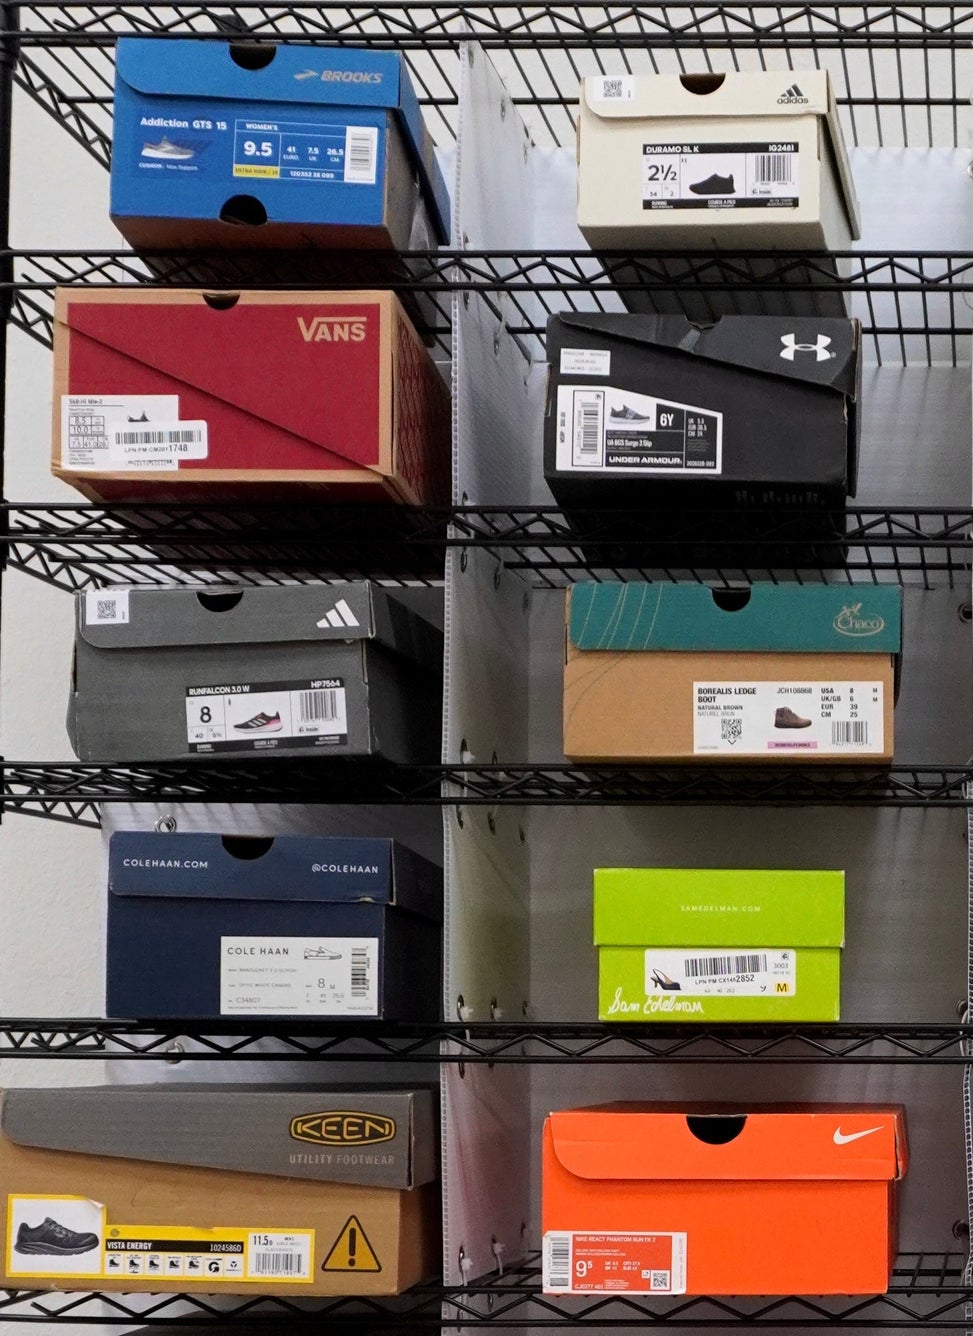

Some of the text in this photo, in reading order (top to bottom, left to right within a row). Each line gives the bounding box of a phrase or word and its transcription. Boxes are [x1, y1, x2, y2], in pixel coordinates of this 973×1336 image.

[321, 70, 382, 84] BROOKS
[140, 117, 227, 130] Addiction GTS 15
[243, 140, 272, 156] 9.5
[297, 317, 367, 342] VANS
[660, 413, 674, 427] 6Y
[609, 456, 639, 464] UNDER
[838, 616, 881, 629] Chaco
[310, 679, 340, 689] HP7564
[189, 686, 230, 696] RUNFALCON
[200, 706, 212, 724] 8
[123, 859, 208, 869] COLEHAAN.COM
[311, 863, 378, 874] @COLEHAAN
[227, 947, 289, 956] COLE HAAN
[318, 978, 325, 989] 8
[736, 974, 755, 982] 2852
[777, 984, 787, 992] M
[608, 987, 704, 1015] Sam Edelman
[298, 1117, 389, 1138] KEEN
[289, 1154, 395, 1165] UTILITY FOOTWEAR
[253, 1235, 269, 1246] 11.5
[107, 1241, 152, 1252] VISTA ENERGY
